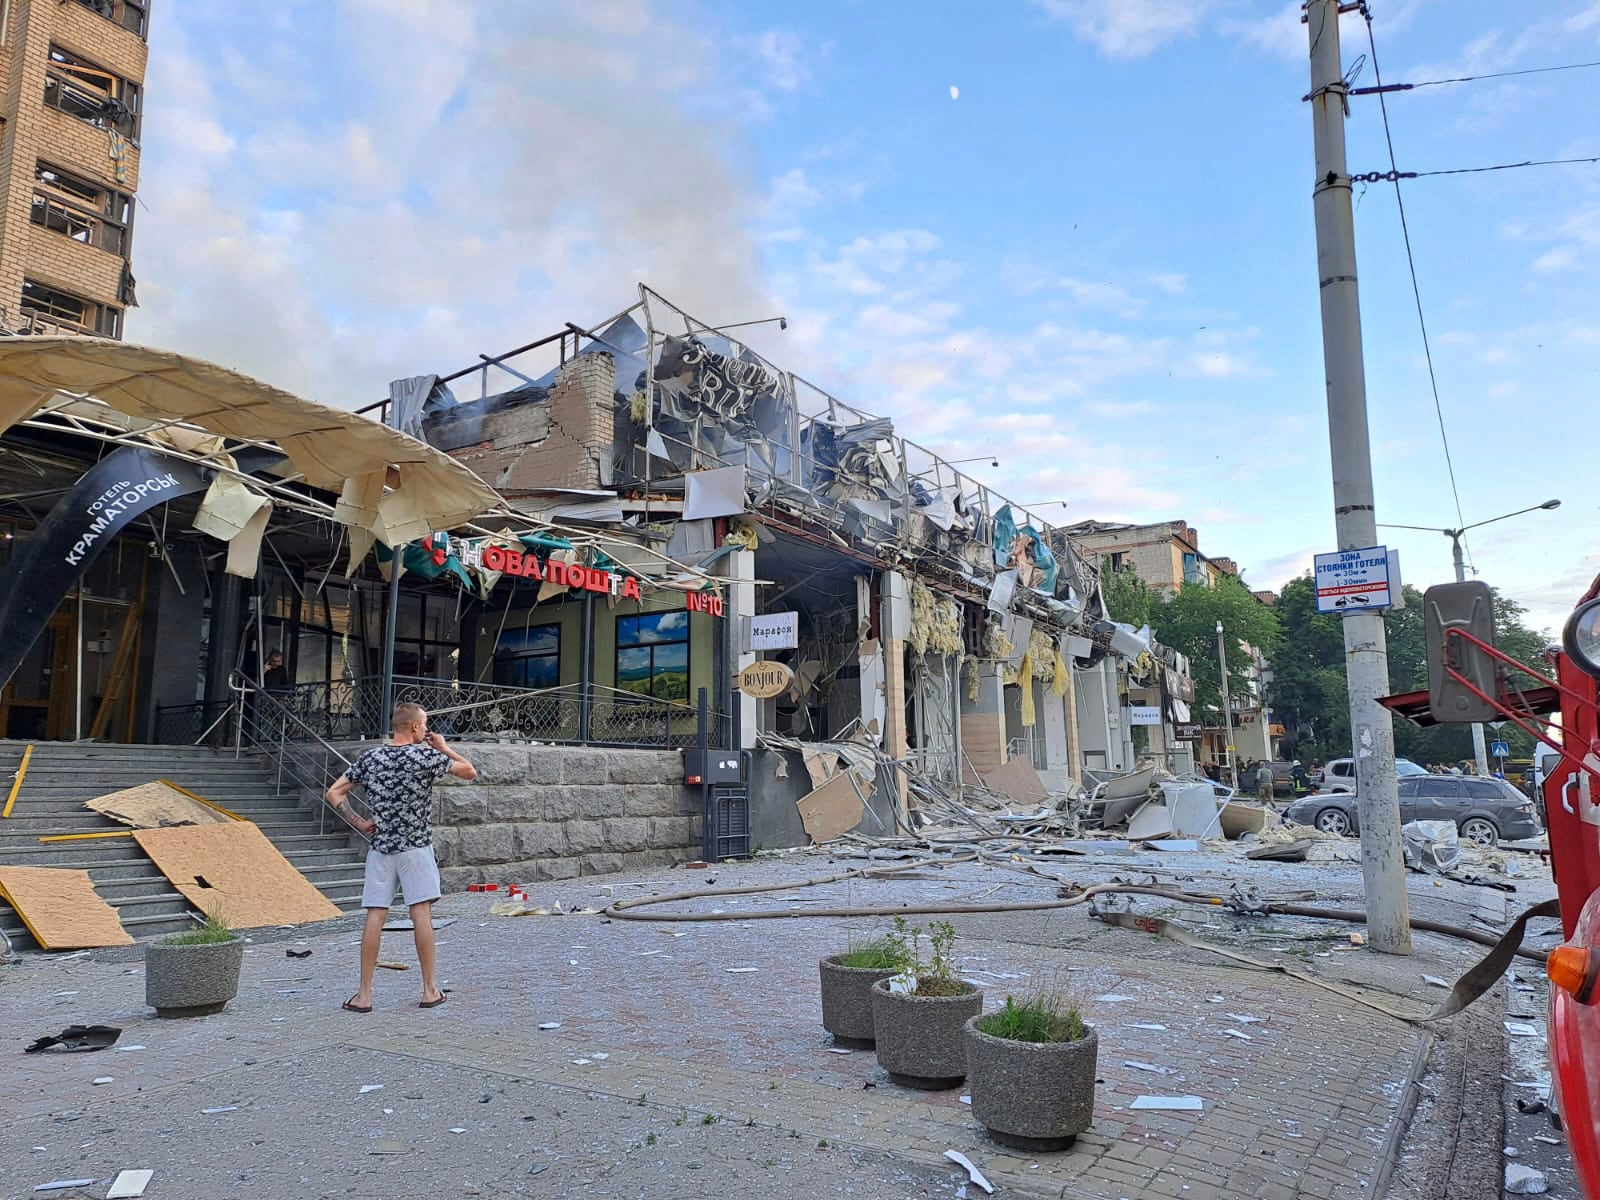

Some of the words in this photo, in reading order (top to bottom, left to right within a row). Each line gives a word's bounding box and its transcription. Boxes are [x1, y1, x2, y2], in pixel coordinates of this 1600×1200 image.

[86, 480, 131, 516] ГОТЕЛЬ
[65, 473, 180, 566] КРАМАТОРСЬК
[1317, 562, 1354, 573] СТОЯНКИ
[1355, 557, 1386, 569] ГОТЕЛЯ
[1340, 552, 1361, 562] ЗОНА
[461, 540, 542, 580] НОВА
[545, 559, 640, 601] ПОШТА
[687, 590, 723, 617] №10
[753, 625, 792, 638] Марафон
[744, 671, 783, 690] BONJOUR
